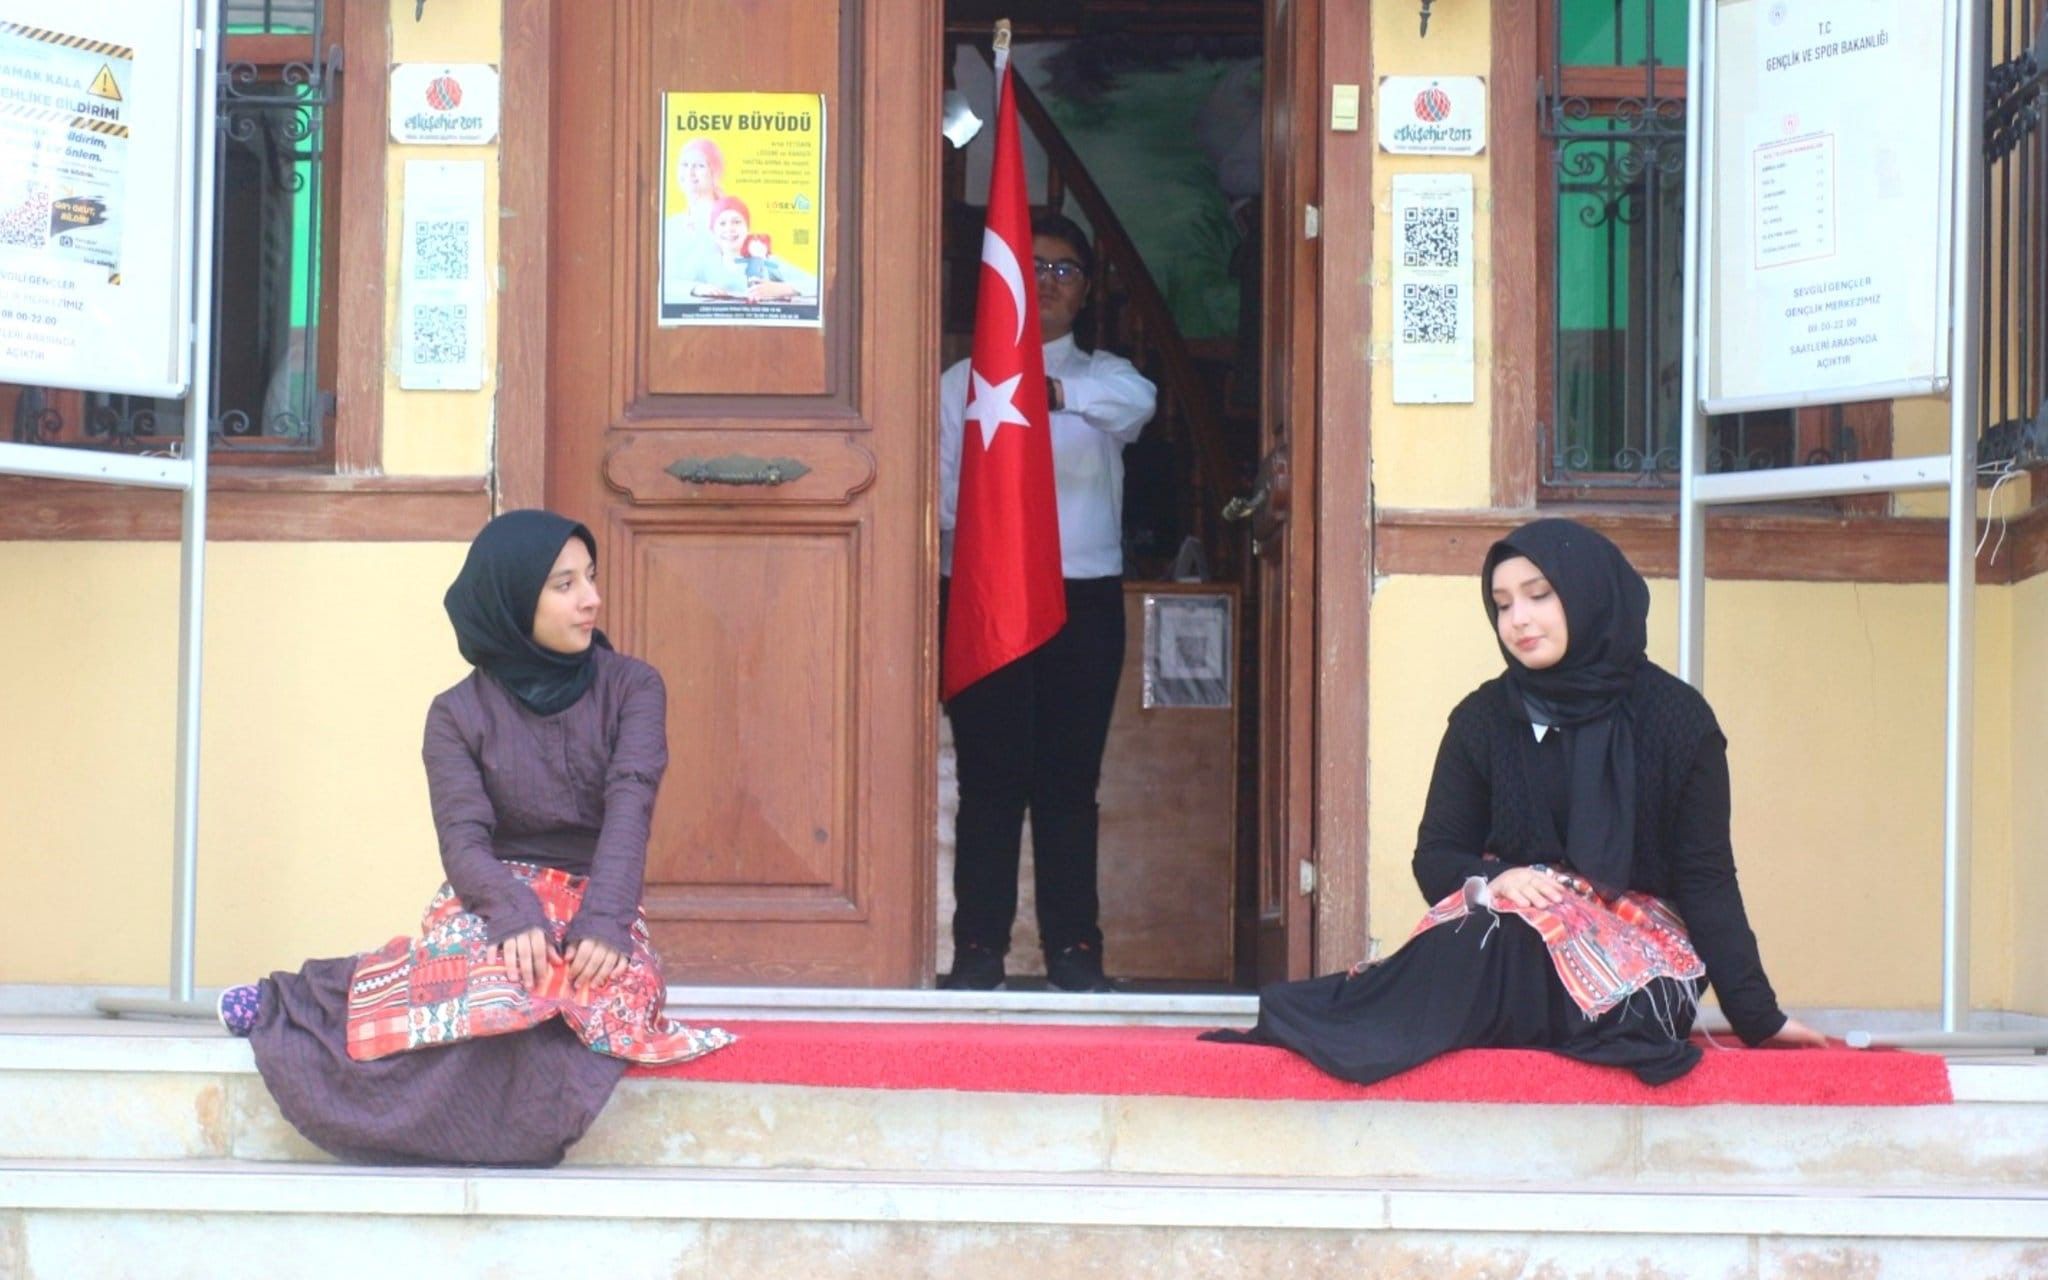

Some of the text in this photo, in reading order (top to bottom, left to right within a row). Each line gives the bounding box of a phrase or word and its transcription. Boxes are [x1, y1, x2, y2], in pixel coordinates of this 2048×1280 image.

[1766, 28, 1889, 72] GENÇLİK VE SPOR BAKANLIĞI
[56, 97, 120, 121] BİLDİRİMİ
[676, 111, 811, 132] LÖSEV BÜYÜDÜ
[1793, 276, 1871, 298] SEVGİLİ GENÇLER
[1830, 332, 1878, 350] ARASINDA
[1816, 354, 1852, 369] AÇIKTIR
